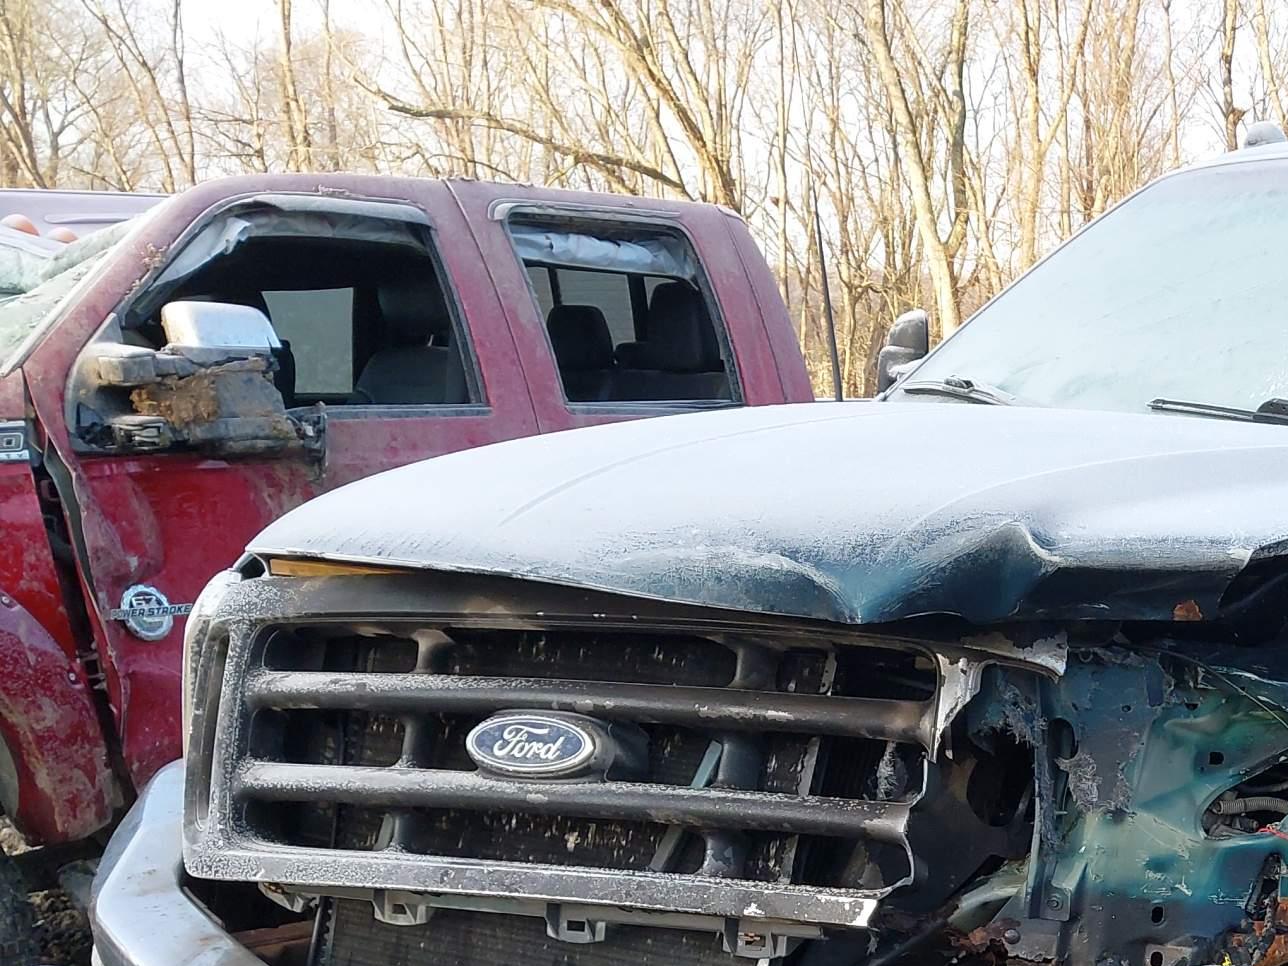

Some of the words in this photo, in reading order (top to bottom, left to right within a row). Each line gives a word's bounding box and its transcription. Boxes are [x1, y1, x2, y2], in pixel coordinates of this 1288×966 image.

[111, 608, 145, 619] POWER
[148, 604, 192, 617] STROKE
[493, 724, 567, 760] Ford
